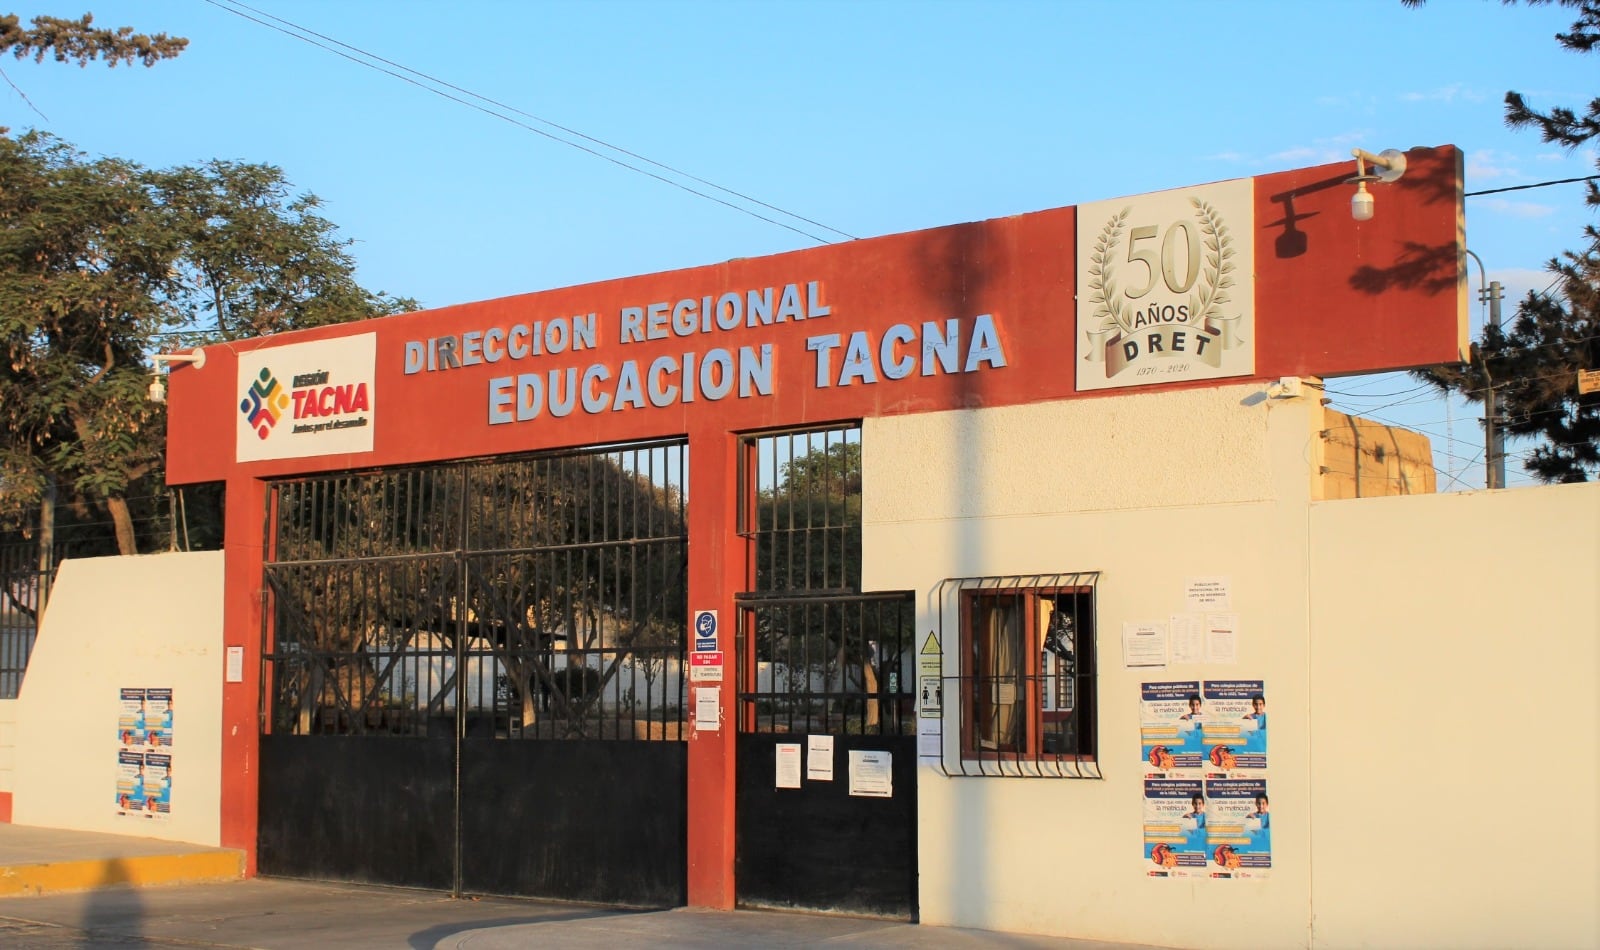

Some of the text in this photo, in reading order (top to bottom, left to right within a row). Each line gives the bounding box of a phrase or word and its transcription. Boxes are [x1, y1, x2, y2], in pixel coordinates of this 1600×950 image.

[1125, 220, 1200, 299] 50
[404, 281, 830, 375] DIRECCION REGIONAL
[1134, 302, 1189, 328] AÑOS
[1123, 331, 1211, 362] DRET
[293, 369, 329, 388] REGIÓN
[488, 314, 1007, 425] EDUCACION TACNA
[1136, 366, 1157, 376] 1970
[1167, 364, 1190, 373] 2020
[292, 383, 369, 419] TACNA
